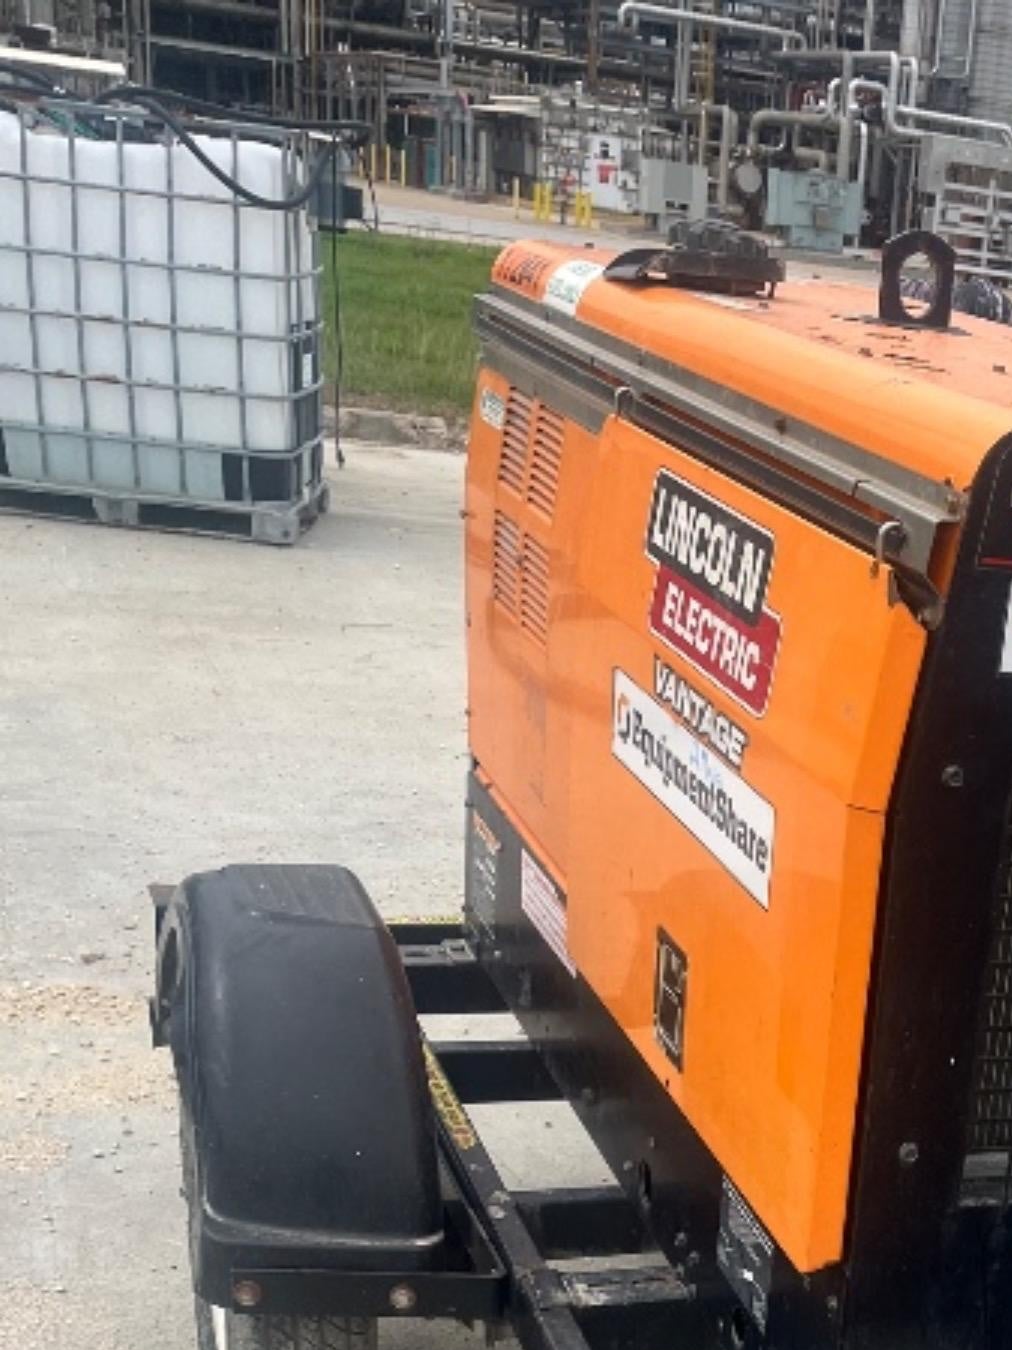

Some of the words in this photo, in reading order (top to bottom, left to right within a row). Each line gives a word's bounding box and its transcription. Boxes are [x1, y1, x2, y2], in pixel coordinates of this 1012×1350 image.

[653, 486, 765, 614] LINCOLN
[661, 580, 761, 692] ELECTRIC
[655, 658, 747, 768] VANTAGE
[631, 707, 769, 874] EquipmentShare
